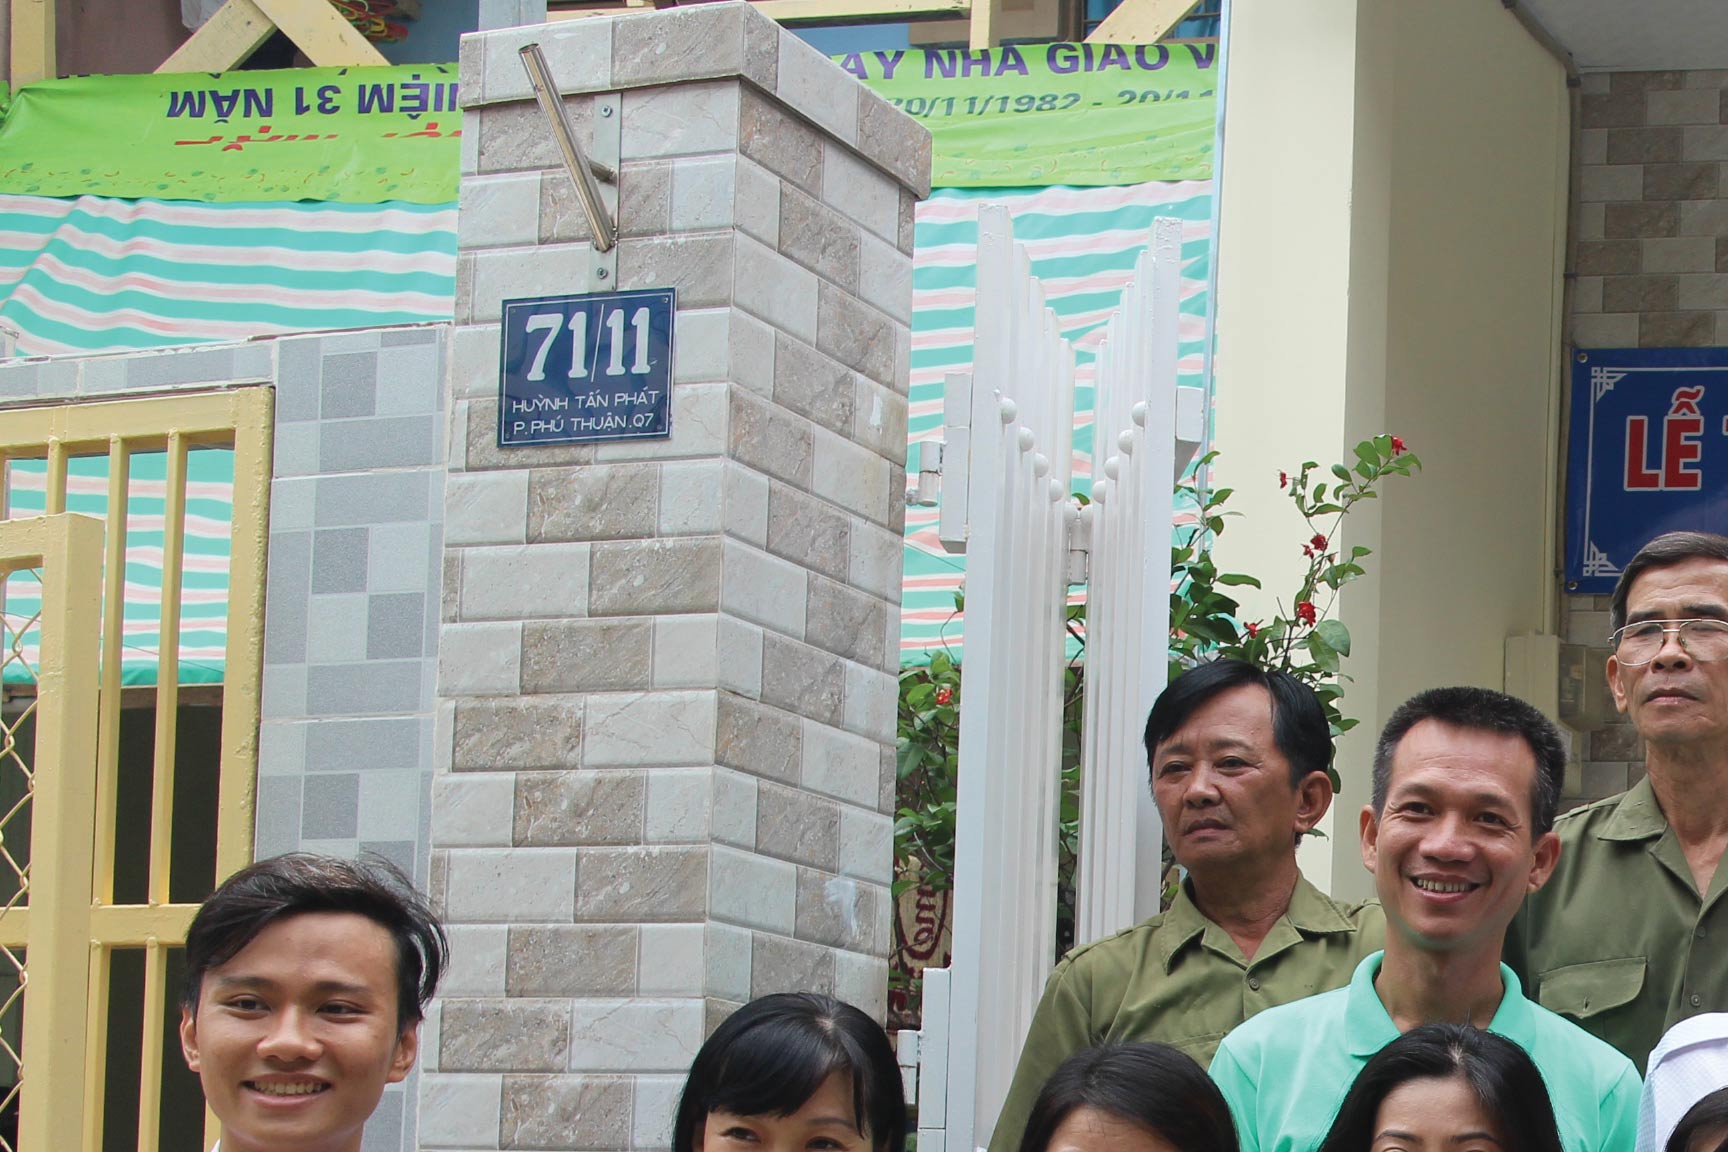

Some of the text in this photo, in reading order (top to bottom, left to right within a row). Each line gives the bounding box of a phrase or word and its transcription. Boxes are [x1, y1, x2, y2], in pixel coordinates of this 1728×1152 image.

[166, 87, 274, 124] NĂM
[295, 84, 342, 116] 31
[893, 92, 1081, 118] 0/11/1982
[525, 303, 651, 383] 71/11
[512, 386, 660, 414] HUỲNH TẤN PHÁT
[1624, 385, 1705, 492] LỄ
